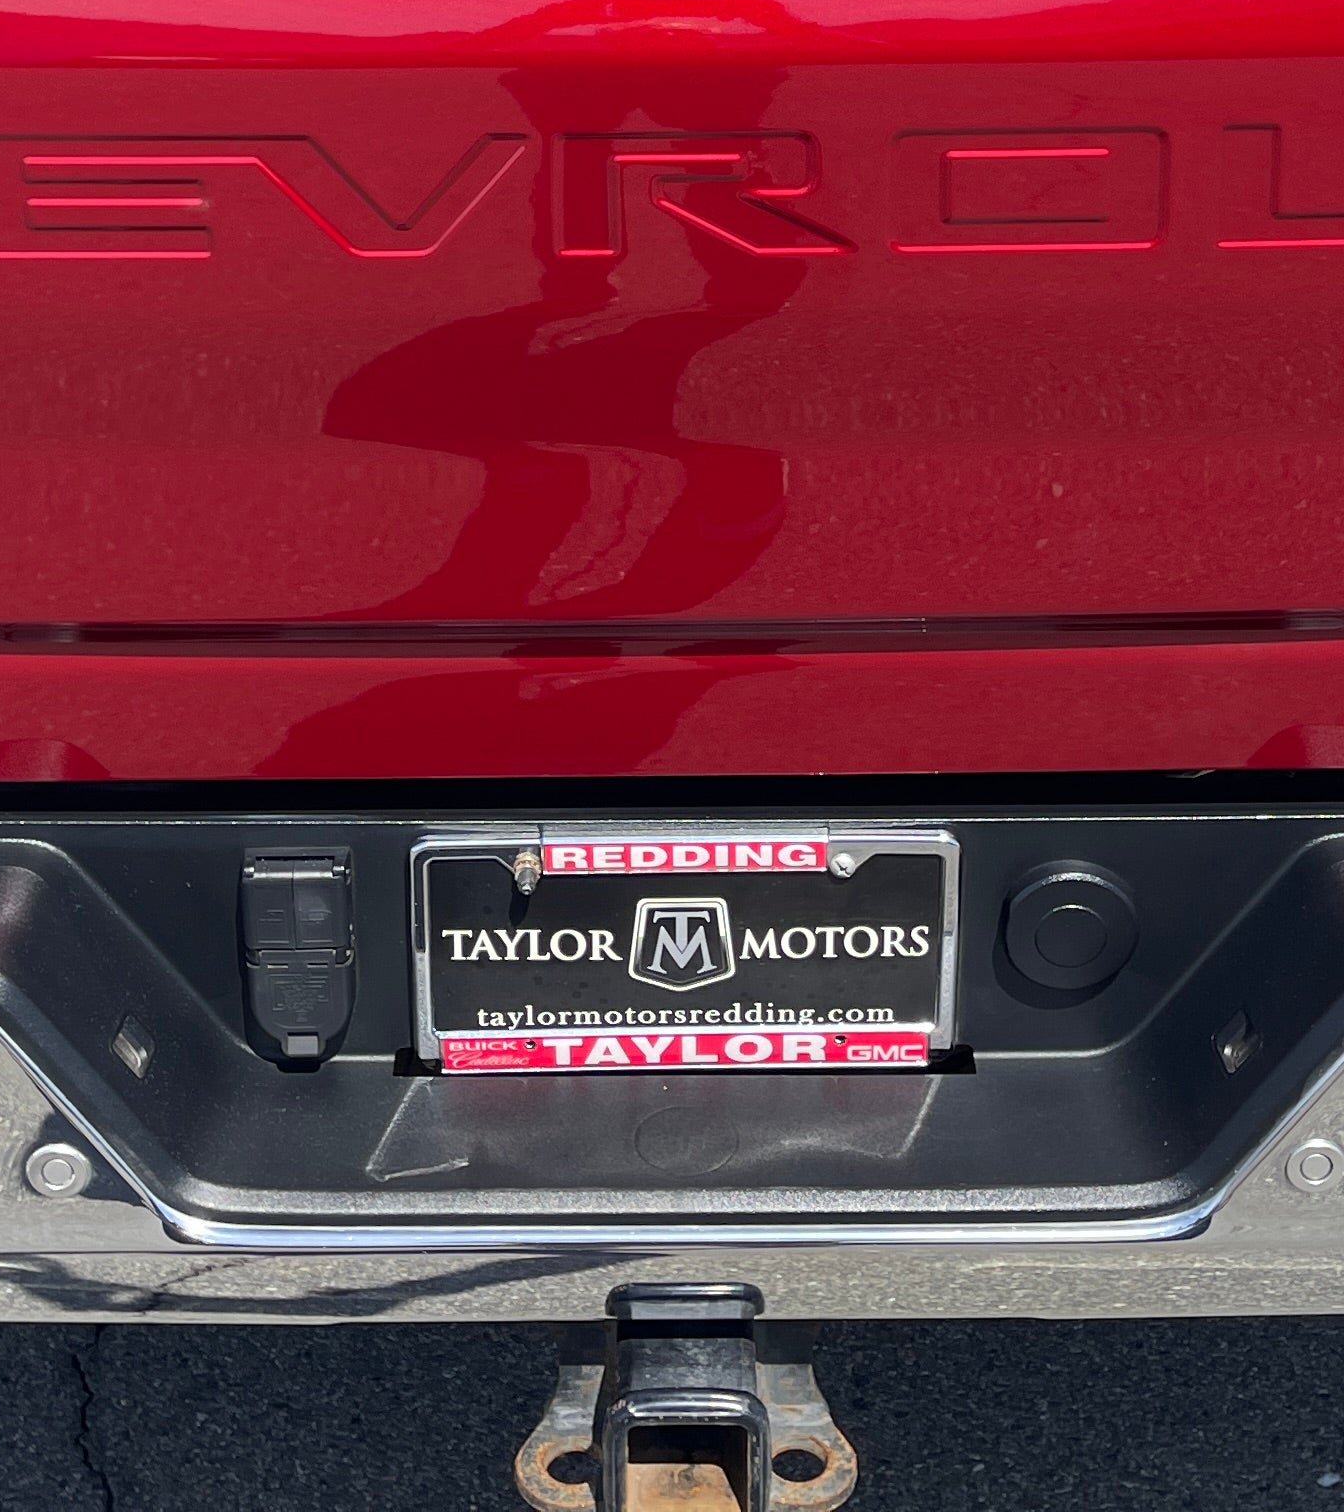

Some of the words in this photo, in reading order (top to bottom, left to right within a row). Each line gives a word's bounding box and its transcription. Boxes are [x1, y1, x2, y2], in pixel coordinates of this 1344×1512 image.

[550, 844, 819, 869] REDDING
[441, 928, 623, 963] TAYLOR
[738, 924, 931, 961] MOTORS
[477, 1002, 896, 1031] taylormotorsredding.com
[448, 1040, 519, 1052] BUICK
[542, 1035, 828, 1066] TAYLOR
[846, 1044, 924, 1062] GMC
